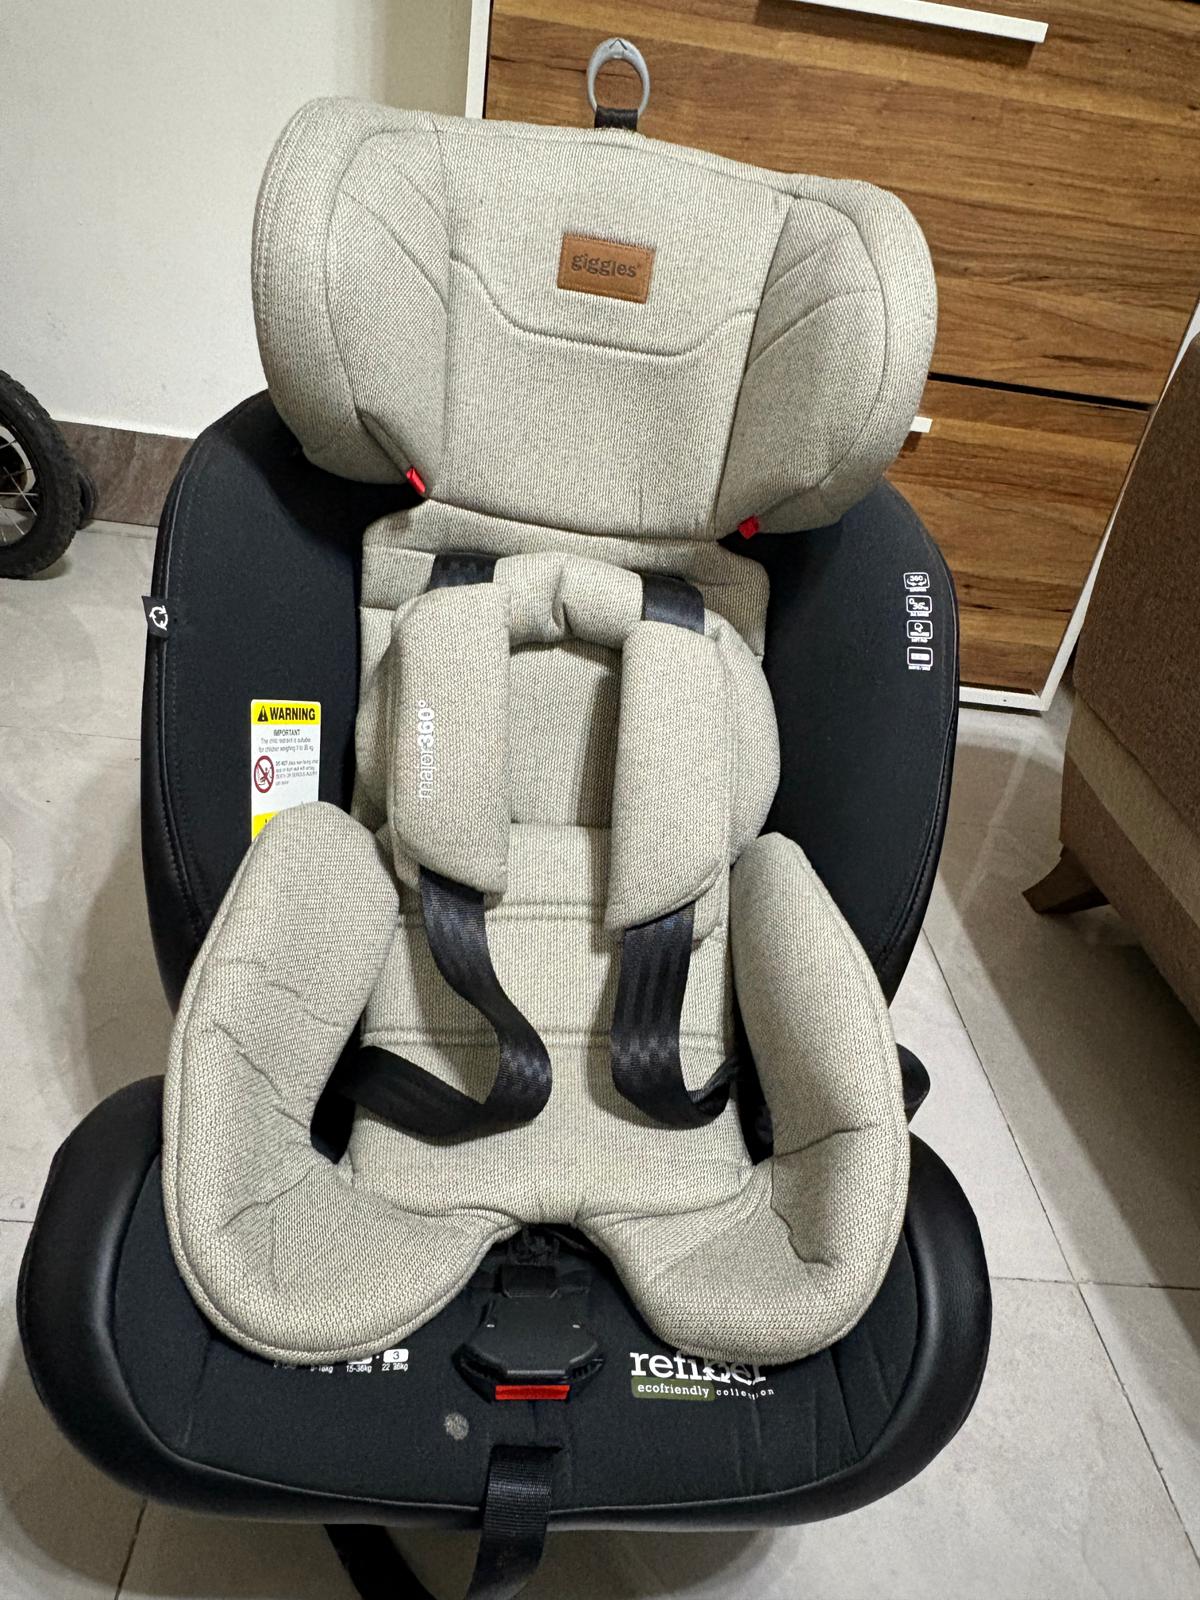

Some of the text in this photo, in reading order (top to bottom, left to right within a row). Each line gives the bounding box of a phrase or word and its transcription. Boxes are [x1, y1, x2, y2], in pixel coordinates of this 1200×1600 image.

[571, 253, 637, 278] giggles
[269, 707, 316, 720] WARNING
[273, 729, 301, 737] IMPORTANT
[392, 1350, 400, 1360] 3
[637, 1382, 710, 1398] ecofriendly
